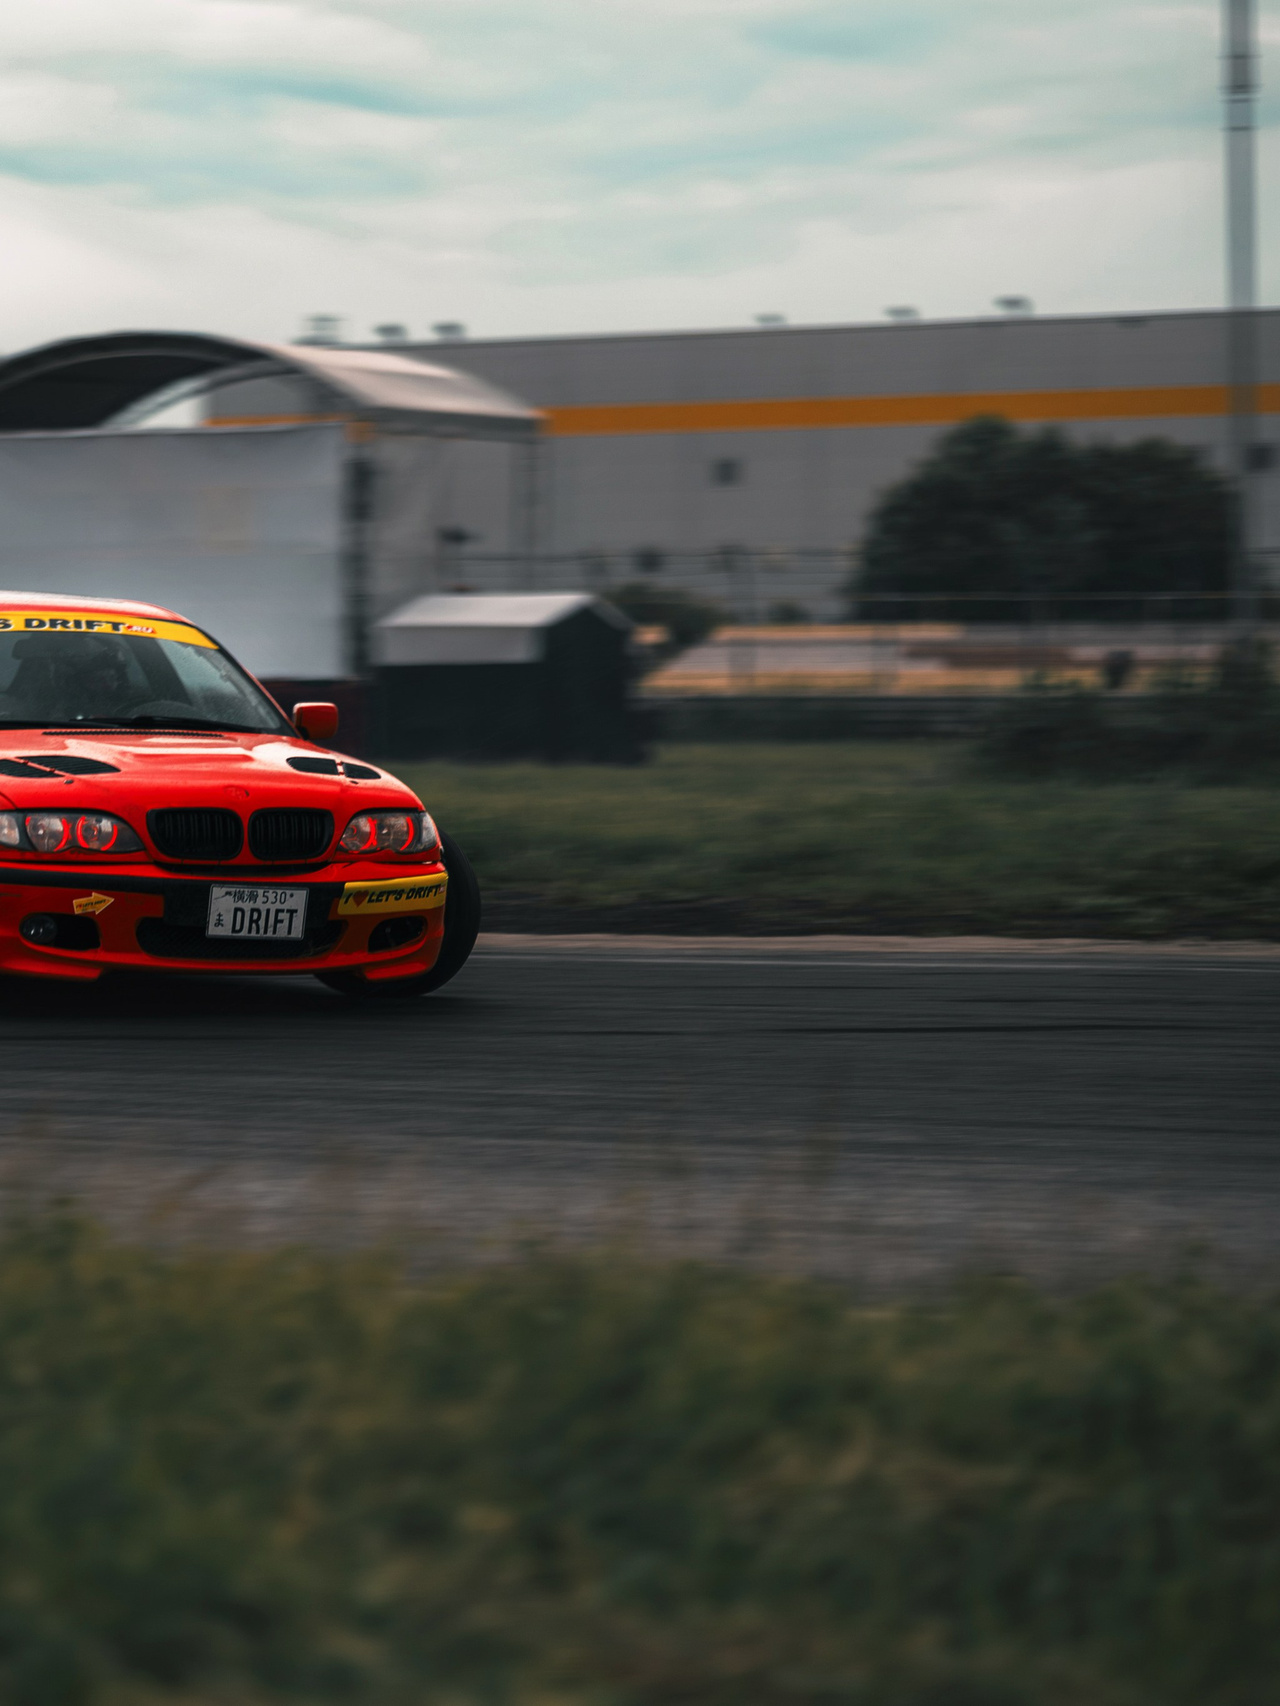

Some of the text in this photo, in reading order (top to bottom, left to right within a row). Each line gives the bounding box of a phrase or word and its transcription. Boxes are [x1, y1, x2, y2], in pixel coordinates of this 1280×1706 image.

[261, 890, 287, 905] 530
[367, 888, 404, 904] LET'S
[405, 883, 441, 900] DRIFT
[214, 912, 224, 928] ま
[231, 907, 298, 936] DRIFT
